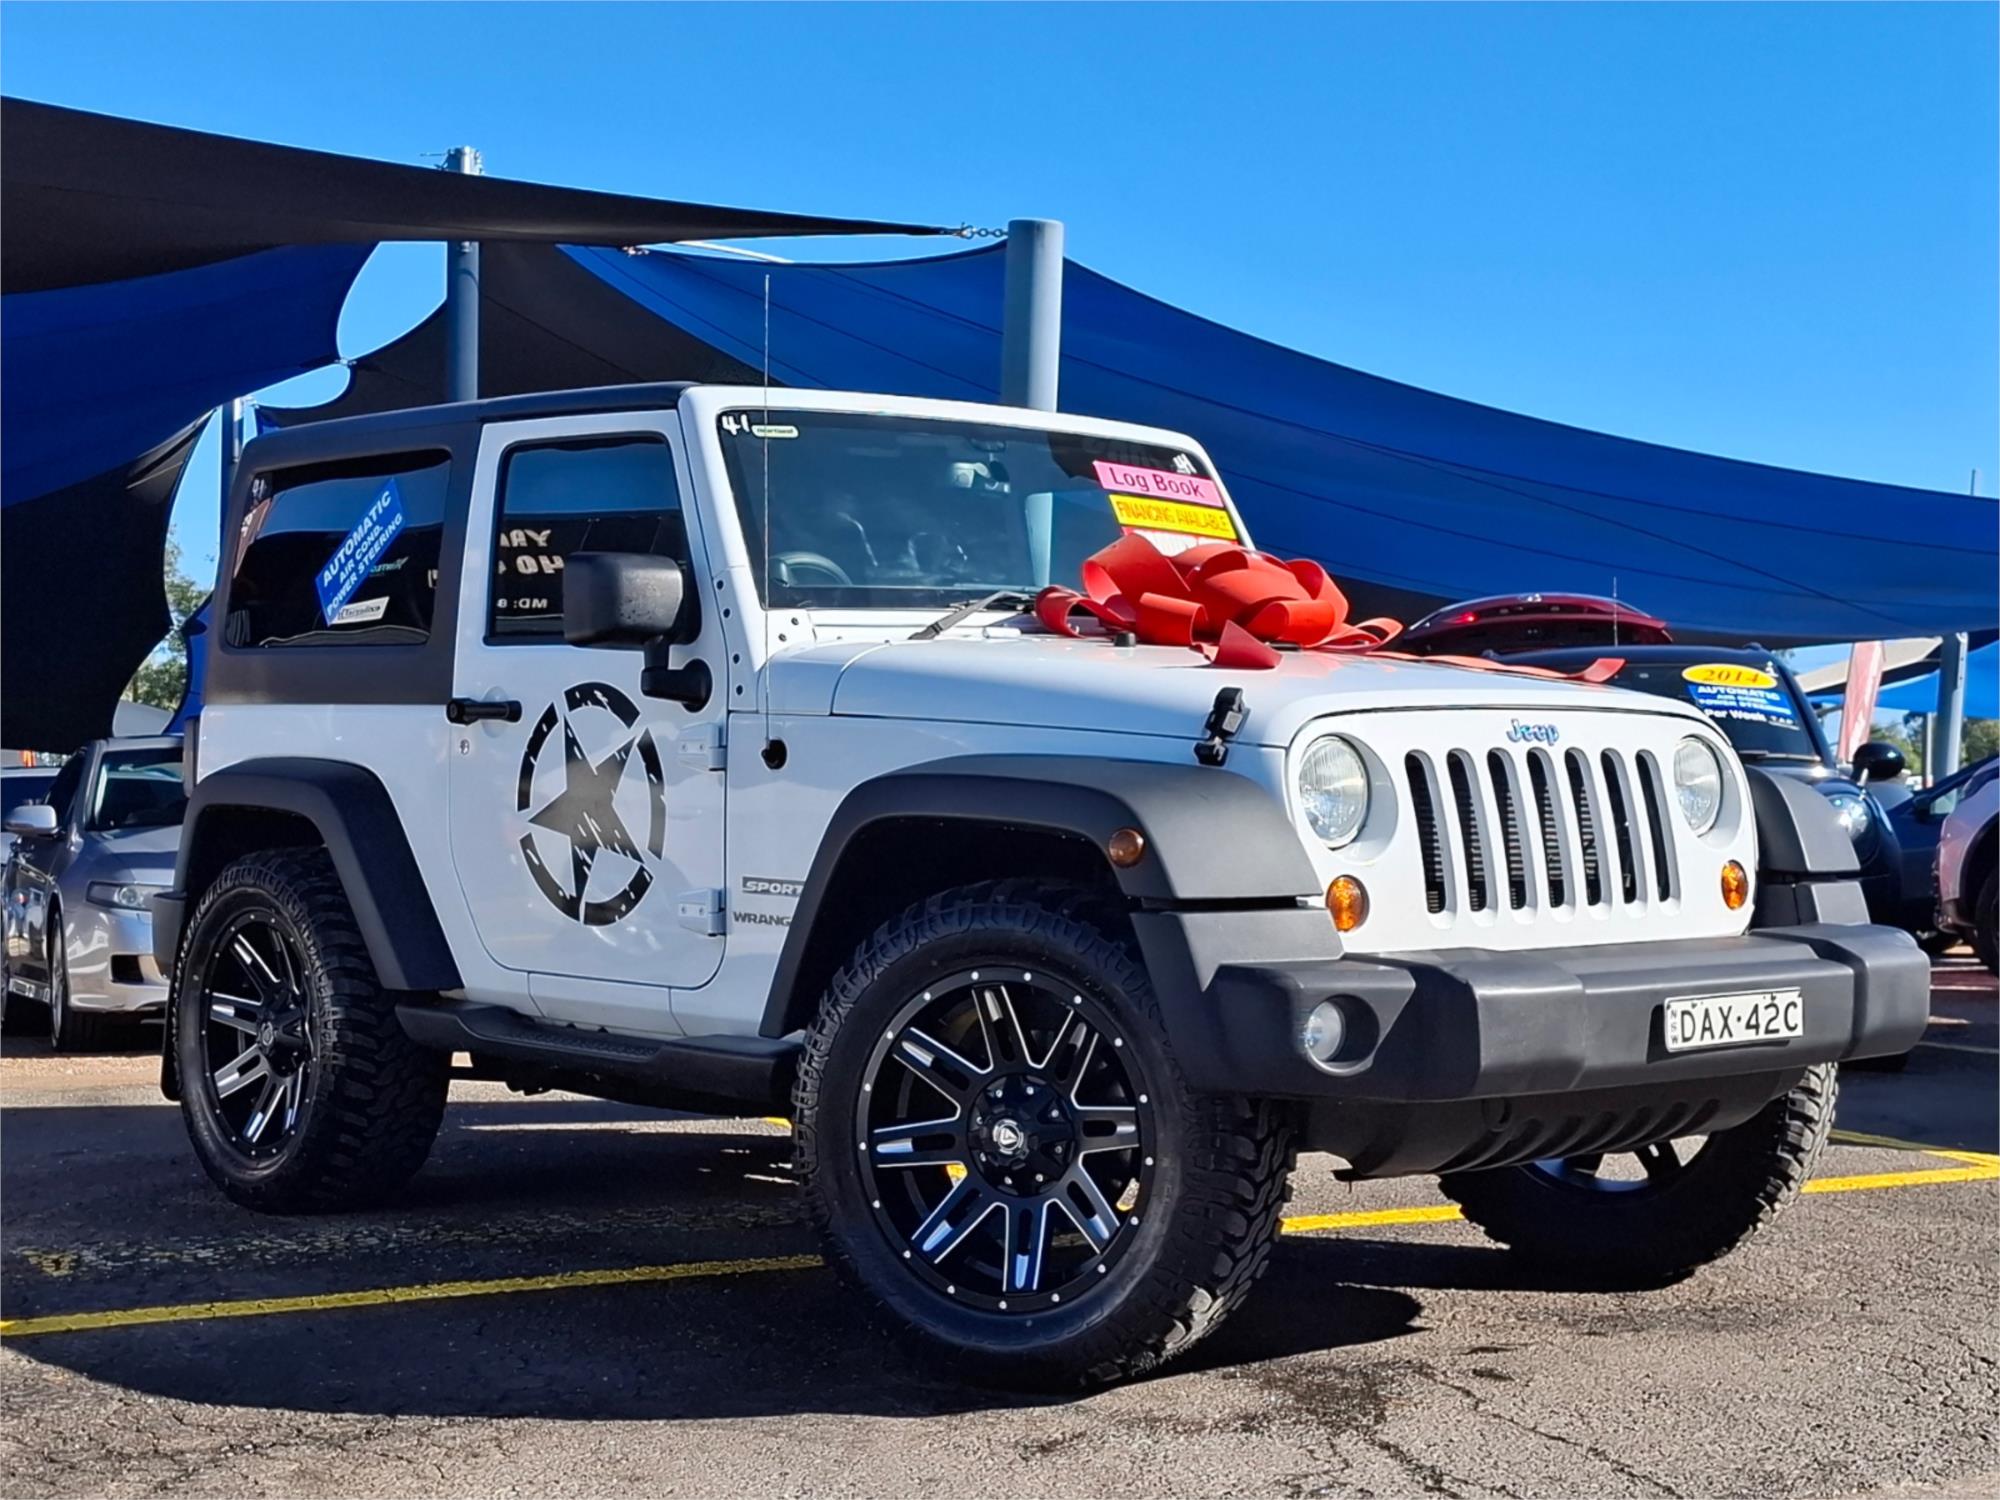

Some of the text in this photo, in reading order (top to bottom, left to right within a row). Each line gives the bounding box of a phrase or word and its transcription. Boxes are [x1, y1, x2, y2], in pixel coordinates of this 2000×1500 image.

[1109, 467, 1204, 498] Log Book
[1116, 501, 1230, 532] FINANCING AVAILABLE
[323, 490, 392, 588] AUTOMATIC
[339, 524, 384, 584] AIR COND.
[326, 573, 358, 617] POWER
[357, 513, 403, 575] STEERING
[1702, 668, 1760, 684] 2014
[1697, 686, 1781, 701] AUTOMATIC
[1506, 718, 1560, 747] Jeep
[743, 881, 804, 895] SPORT
